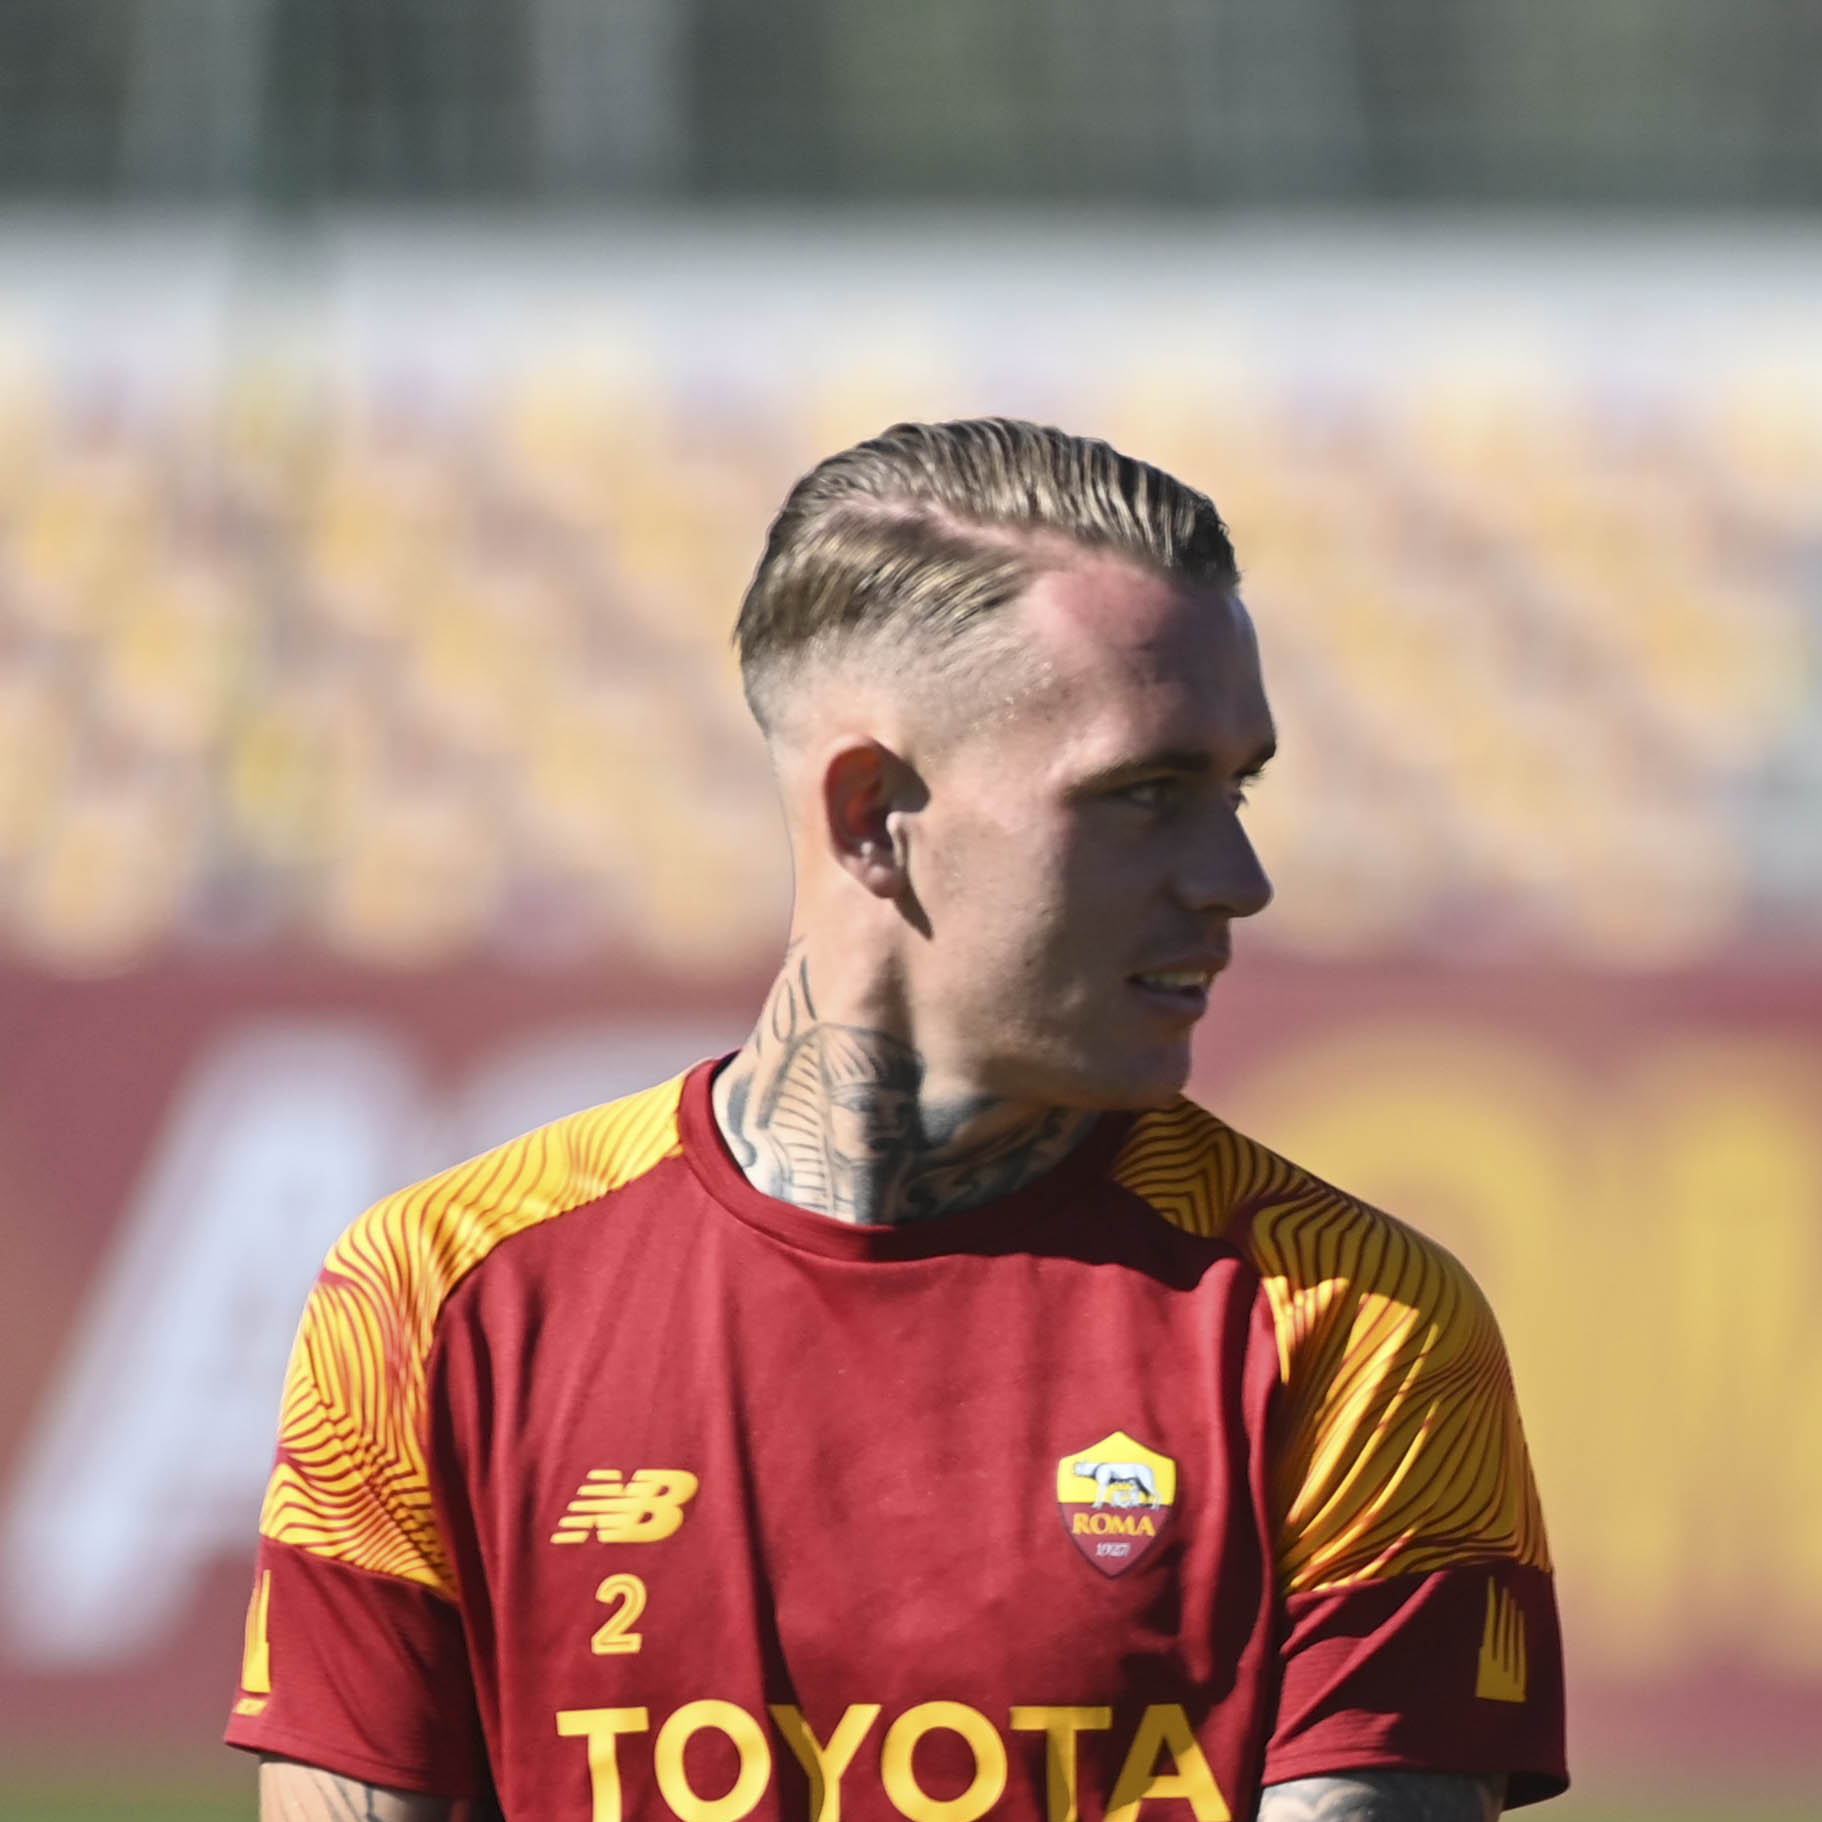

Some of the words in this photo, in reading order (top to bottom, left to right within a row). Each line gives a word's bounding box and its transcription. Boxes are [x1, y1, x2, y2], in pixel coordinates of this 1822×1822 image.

[1072, 1512, 1156, 1536] ROMA
[1096, 1542, 1130, 1557] 1927
[590, 1573, 647, 1654] 2
